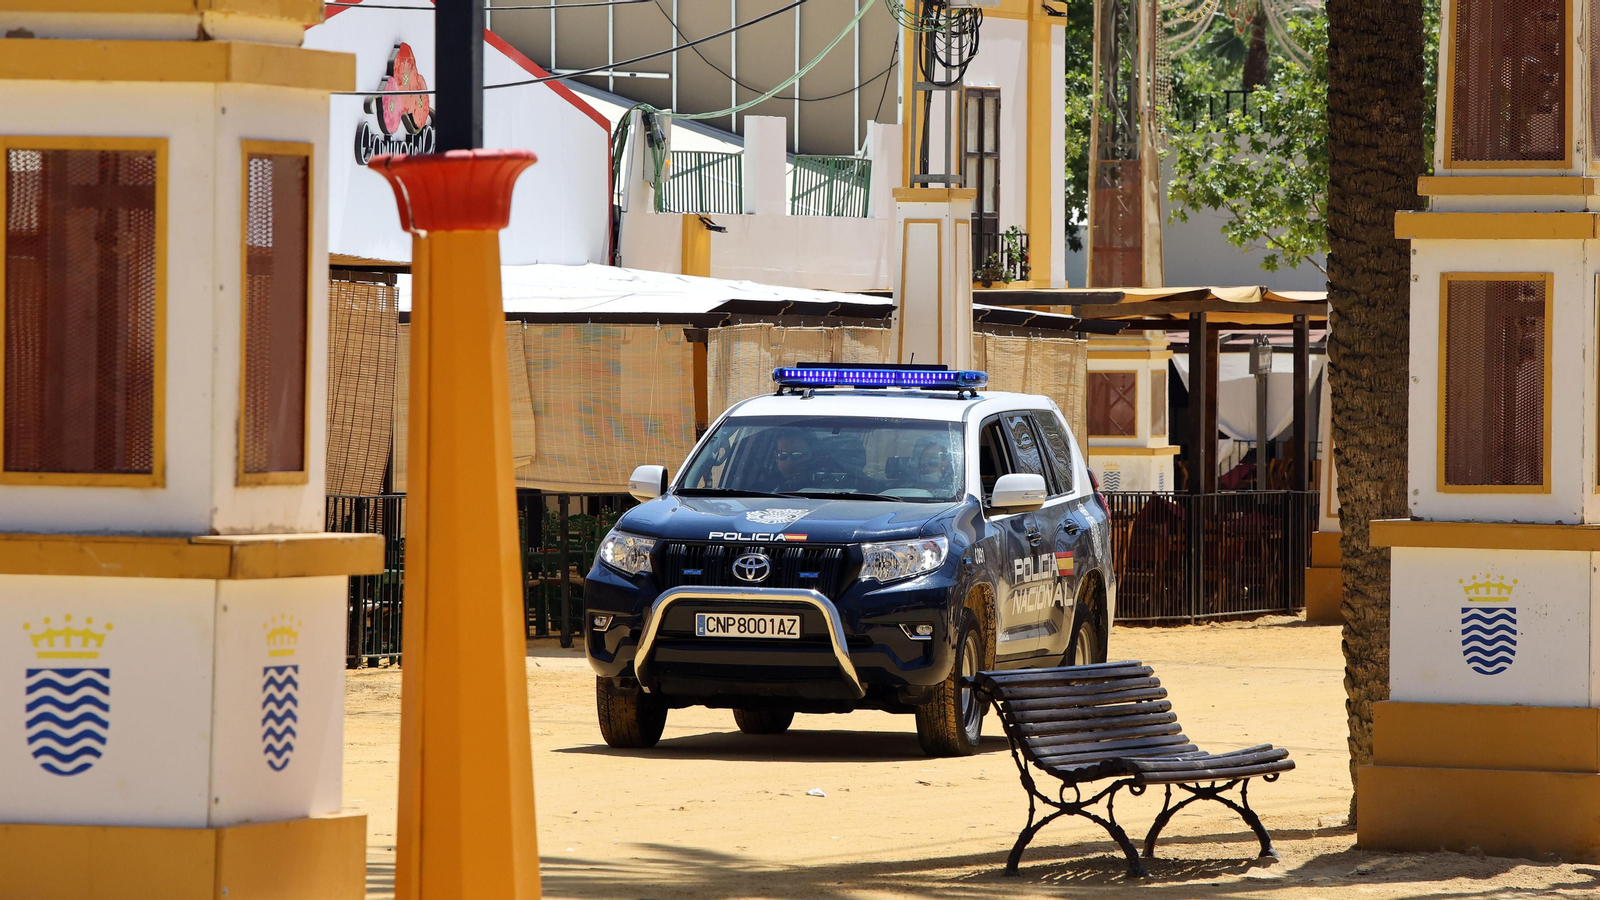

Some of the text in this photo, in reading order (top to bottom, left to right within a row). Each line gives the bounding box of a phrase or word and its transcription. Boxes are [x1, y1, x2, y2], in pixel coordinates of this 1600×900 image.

[708, 531, 786, 542] POLICIA
[1014, 552, 1060, 585] POLICIA
[1011, 582, 1074, 616] NACIONAL
[706, 616, 797, 636] CNP8001AZ
